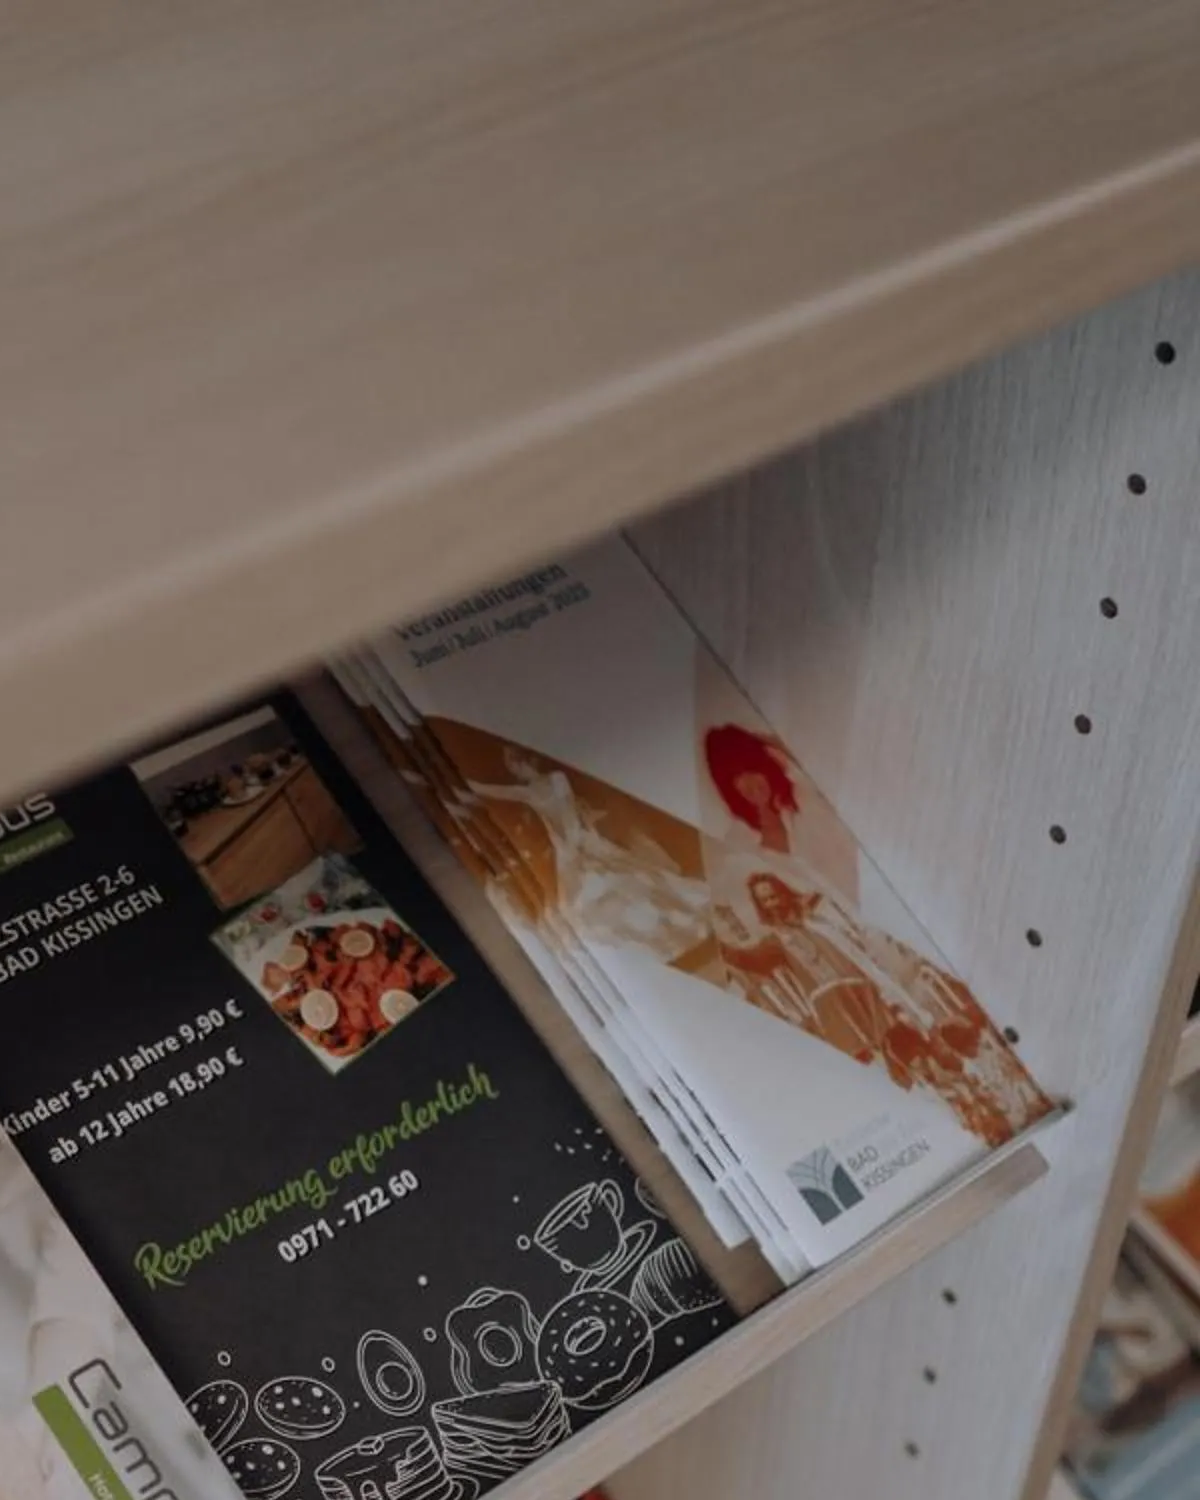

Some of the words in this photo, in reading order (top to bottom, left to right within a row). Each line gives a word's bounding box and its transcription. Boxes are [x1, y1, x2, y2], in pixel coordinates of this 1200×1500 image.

[38, 884, 165, 957] KISSINGEN
[95, 863, 137, 896] 2-6
[69, 1062, 122, 1100] 5-11
[116, 1033, 182, 1079] Jahre
[177, 1007, 227, 1045] 9,90
[222, 997, 244, 1020] €
[45, 1135, 80, 1164] ab
[77, 1118, 110, 1146] 12
[104, 1088, 172, 1137] Jahre
[166, 1056, 228, 1099] 18,90
[223, 1045, 245, 1067] €
[134, 1167, 339, 1288] Reservierung
[324, 1061, 501, 1184] erforderlich
[845, 1143, 880, 1173] BAD
[275, 1217, 336, 1263] 0971
[343, 1185, 392, 1223] 722
[386, 1168, 420, 1198] 60
